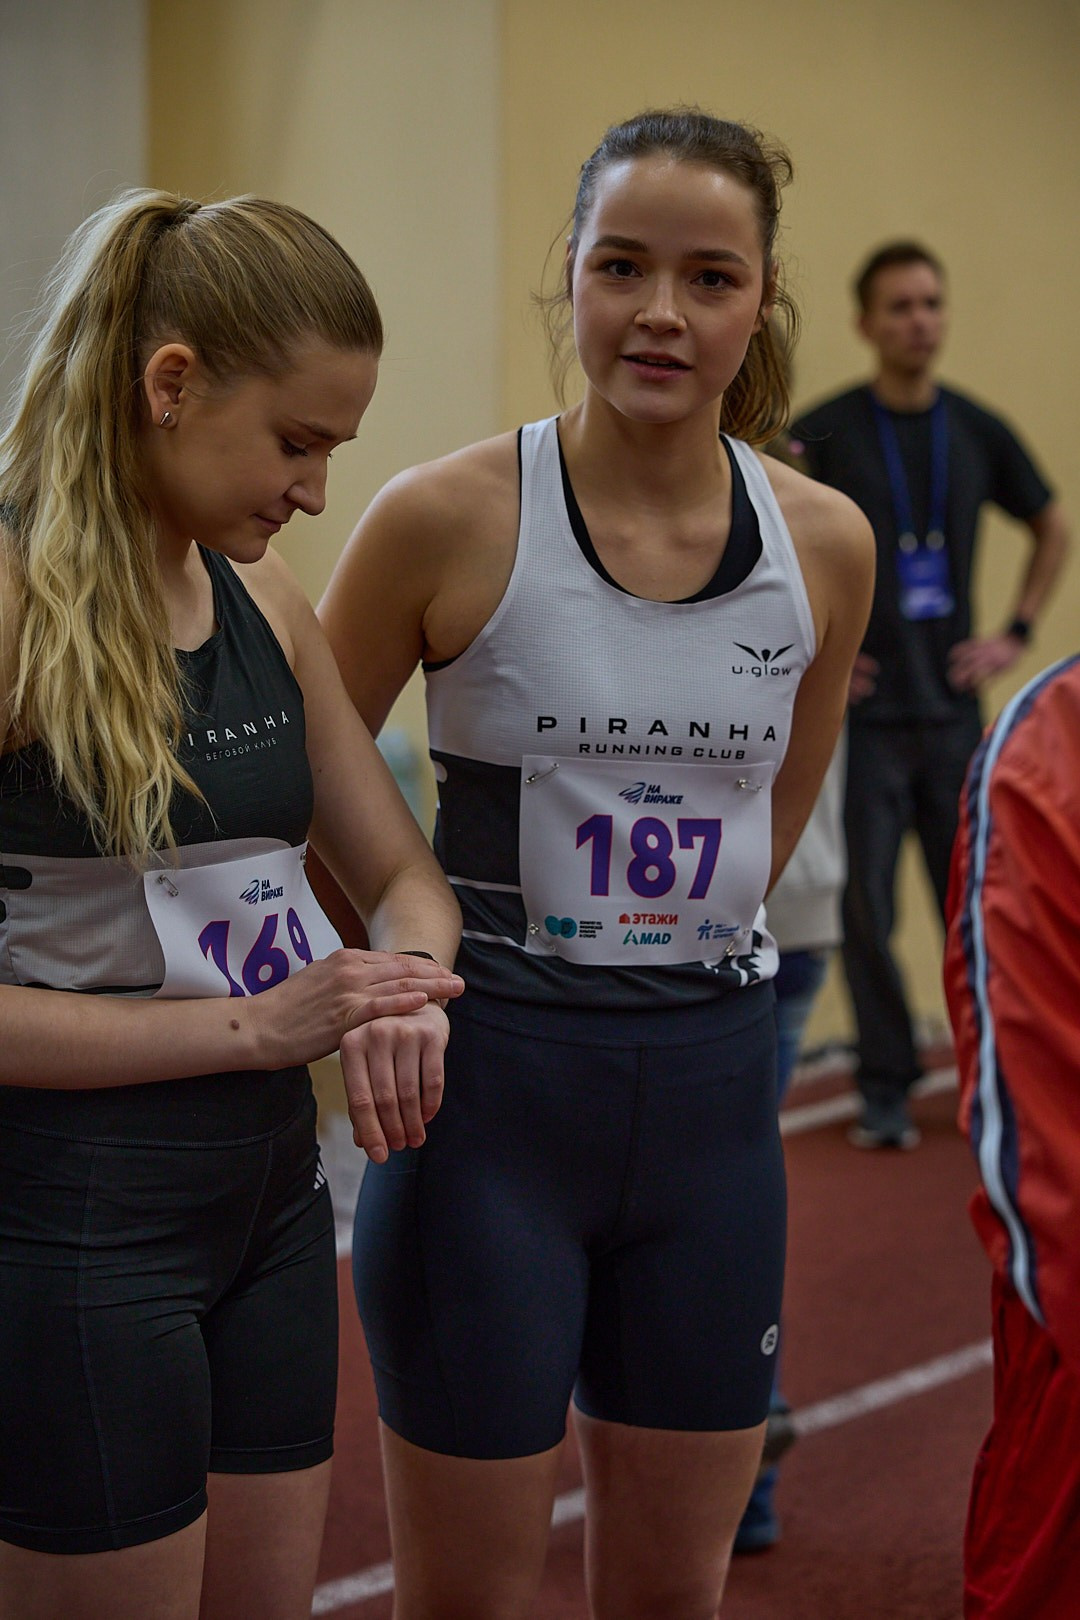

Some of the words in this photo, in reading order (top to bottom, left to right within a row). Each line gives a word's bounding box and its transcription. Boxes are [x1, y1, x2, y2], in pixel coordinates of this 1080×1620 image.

[537, 716, 776, 742] PIRANHA
[205, 743, 252, 761] БЕГОВОЙ
[254, 737, 278, 751] КЛУБ
[579, 743, 683, 757] RUNNING
[693, 747, 746, 760] CLUB
[647, 784, 661, 794] НА
[643, 794, 683, 805] ВИРАЖЕ
[576, 814, 722, 900] 187
[261, 879, 270, 891] НА
[198, 907, 314, 997] 169
